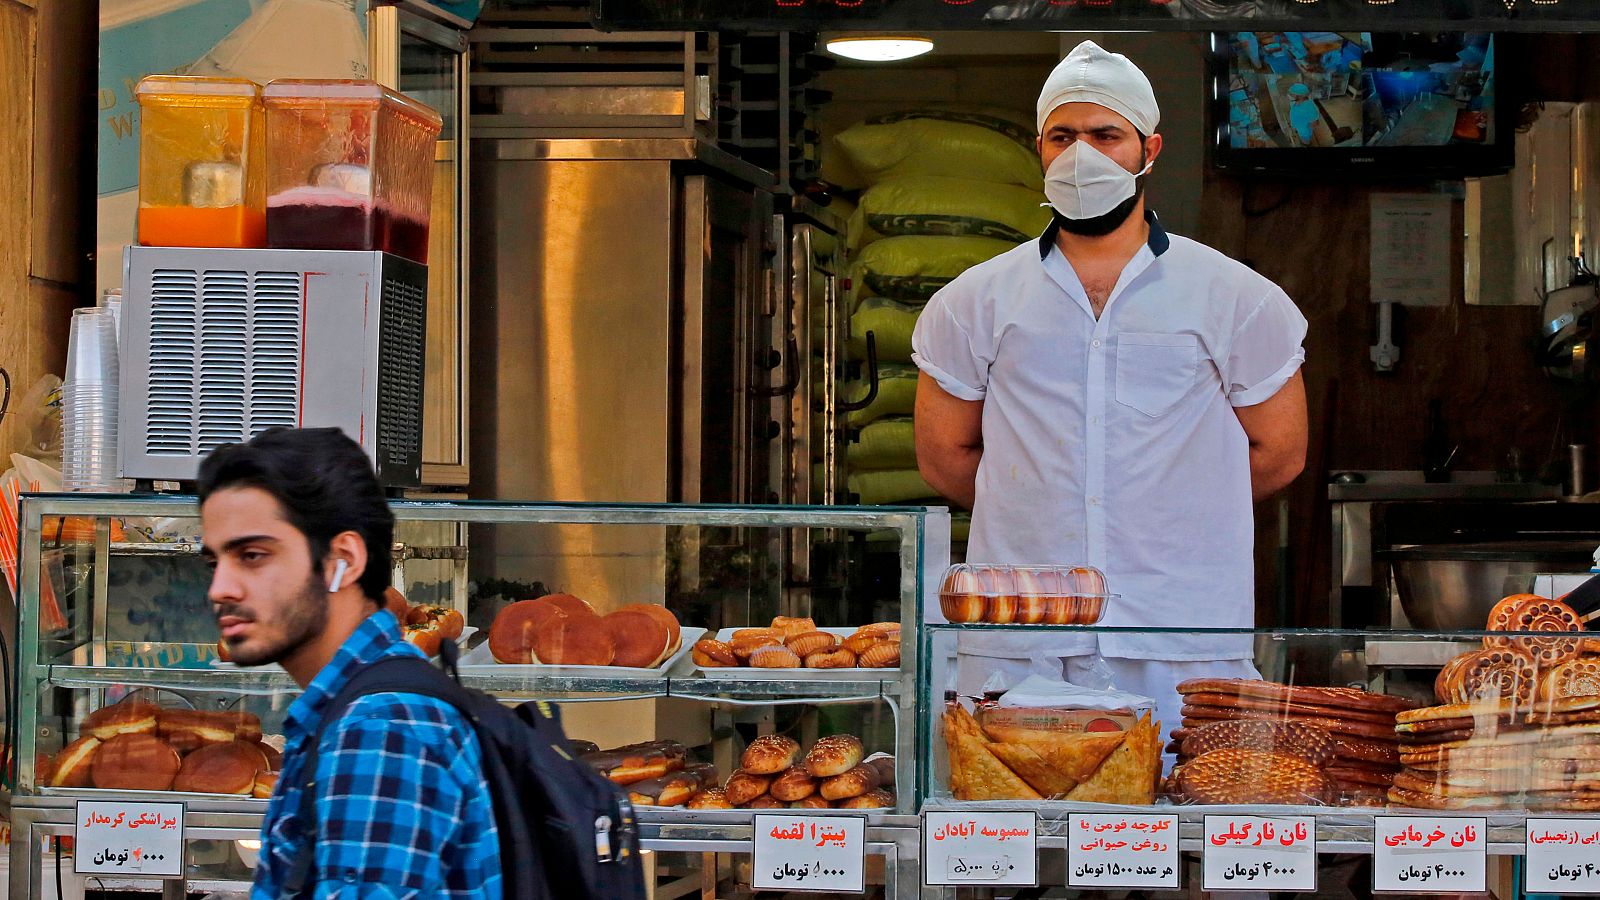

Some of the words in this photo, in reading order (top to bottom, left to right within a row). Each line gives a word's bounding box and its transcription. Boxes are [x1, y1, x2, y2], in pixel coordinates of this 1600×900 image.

[84, 810, 126, 829] کرمدار
[128, 812, 177, 830] پیراشکی
[1080, 819, 1090, 832] با
[1093, 819, 1128, 833] فومن
[1130, 820, 1171, 834] کلوچه
[769, 821, 805, 840] لقمه
[810, 822, 847, 848] پیتزا
[933, 821, 977, 841] آبادان
[980, 825, 1029, 841] سمبوسه
[1210, 821, 1275, 846] نارگیلی
[1279, 822, 1308, 847] نان
[1384, 824, 1446, 848] خرمایی
[1450, 825, 1477, 848] نان
[1080, 837, 1128, 851] حیوانی
[1131, 838, 1168, 852] روغن
[93, 847, 129, 866] تومان
[772, 862, 809, 881] تومان
[1075, 862, 1104, 878] تومان
[1107, 862, 1133, 876] ۱۵۰۰
[1136, 865, 1157, 875] عدد
[1159, 866, 1173, 878] هر
[1223, 862, 1260, 881] تومان
[1262, 861, 1296, 877] ۴۰۰۰
[1398, 865, 1432, 881] تومان
[1434, 864, 1465, 879] ۴۰۰۰
[1548, 864, 1582, 881] تومان
